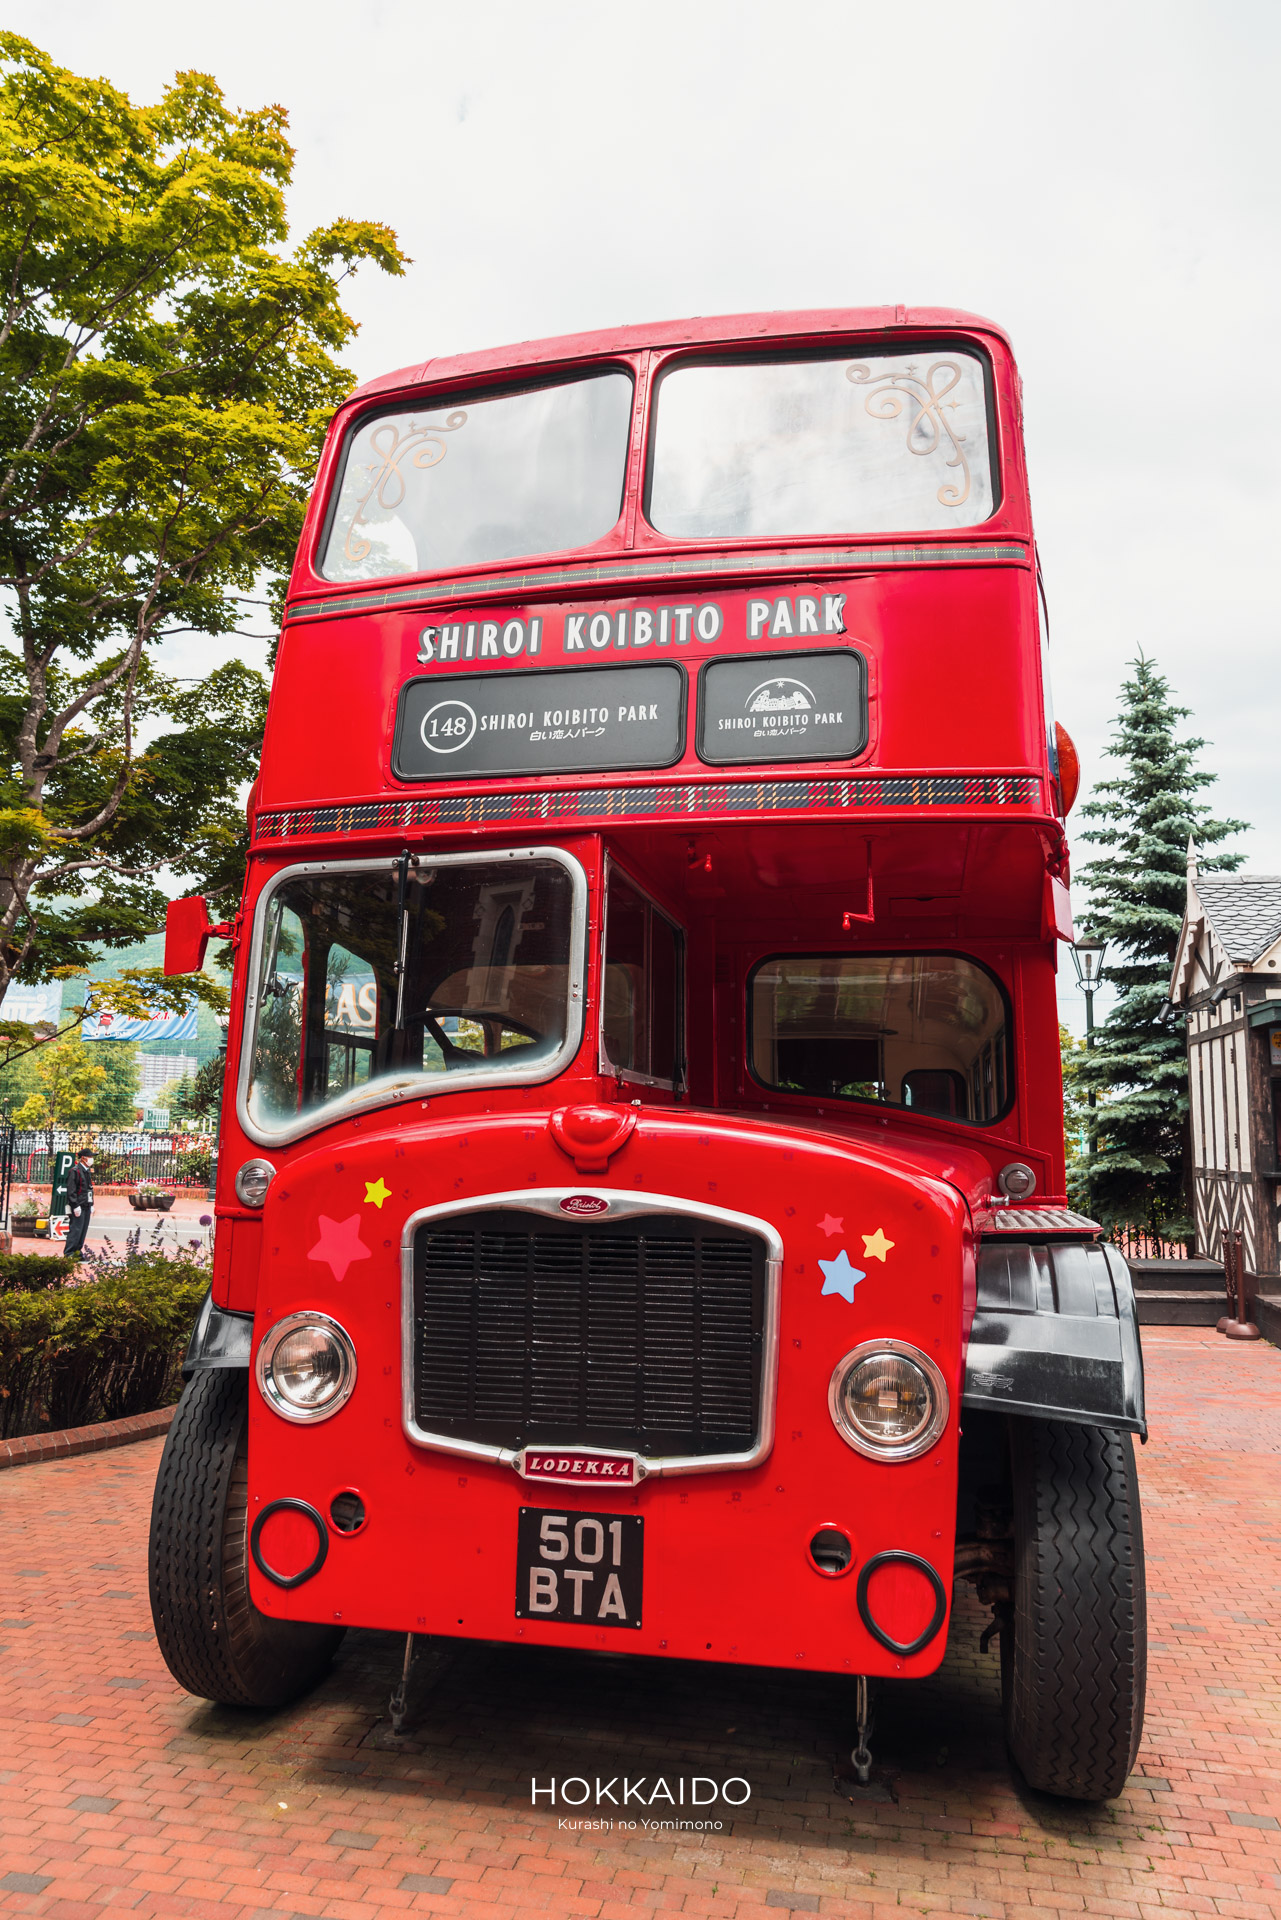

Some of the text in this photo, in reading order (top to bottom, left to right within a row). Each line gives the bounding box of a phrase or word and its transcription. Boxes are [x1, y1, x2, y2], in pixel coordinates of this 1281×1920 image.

[417, 593, 846, 663] SHIROI KOIBITO PARK
[429, 704, 659, 738] 148 SHIROI KOIBITO PARK
[718, 712, 843, 730] SHIROI KOIBITO PARK
[528, 726, 606, 742] 白い恋人パーク
[60, 1154, 73, 1176] P
[566, 1199, 602, 1212] Bristol
[529, 1457, 630, 1477] LODEKKA
[539, 1515, 623, 1567] 501
[528, 1566, 628, 1620] BTA
